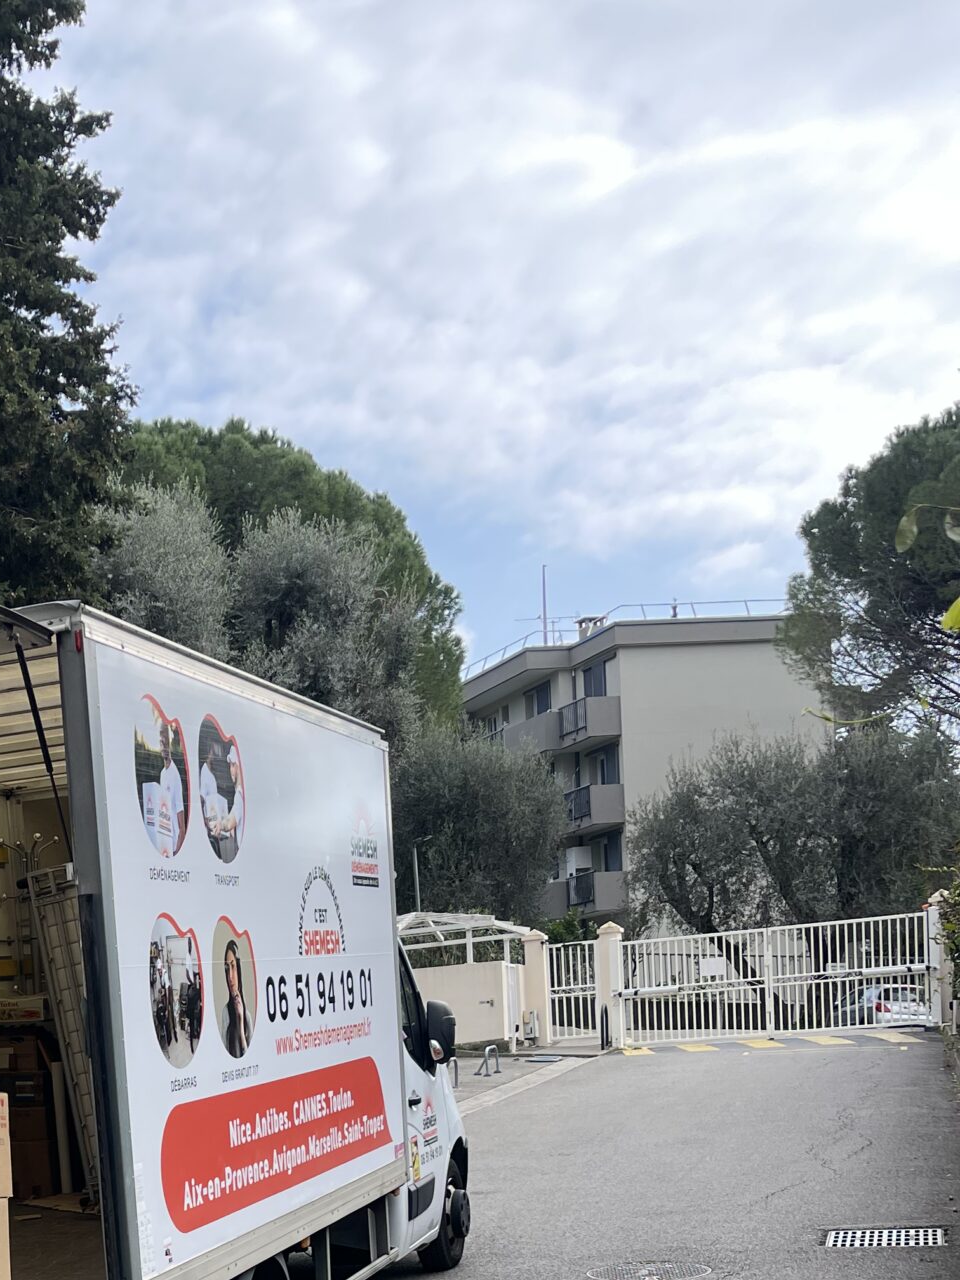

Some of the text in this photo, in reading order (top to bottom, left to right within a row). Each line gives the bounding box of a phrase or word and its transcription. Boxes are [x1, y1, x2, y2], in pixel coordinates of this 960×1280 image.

[149, 866, 190, 882] DÉMÉNAGEMENT
[303, 929, 341, 955] SHEMESH
[265, 968, 373, 1023] 06 51 94 19 01
[170, 1076, 198, 1092] DÉBARRAS
